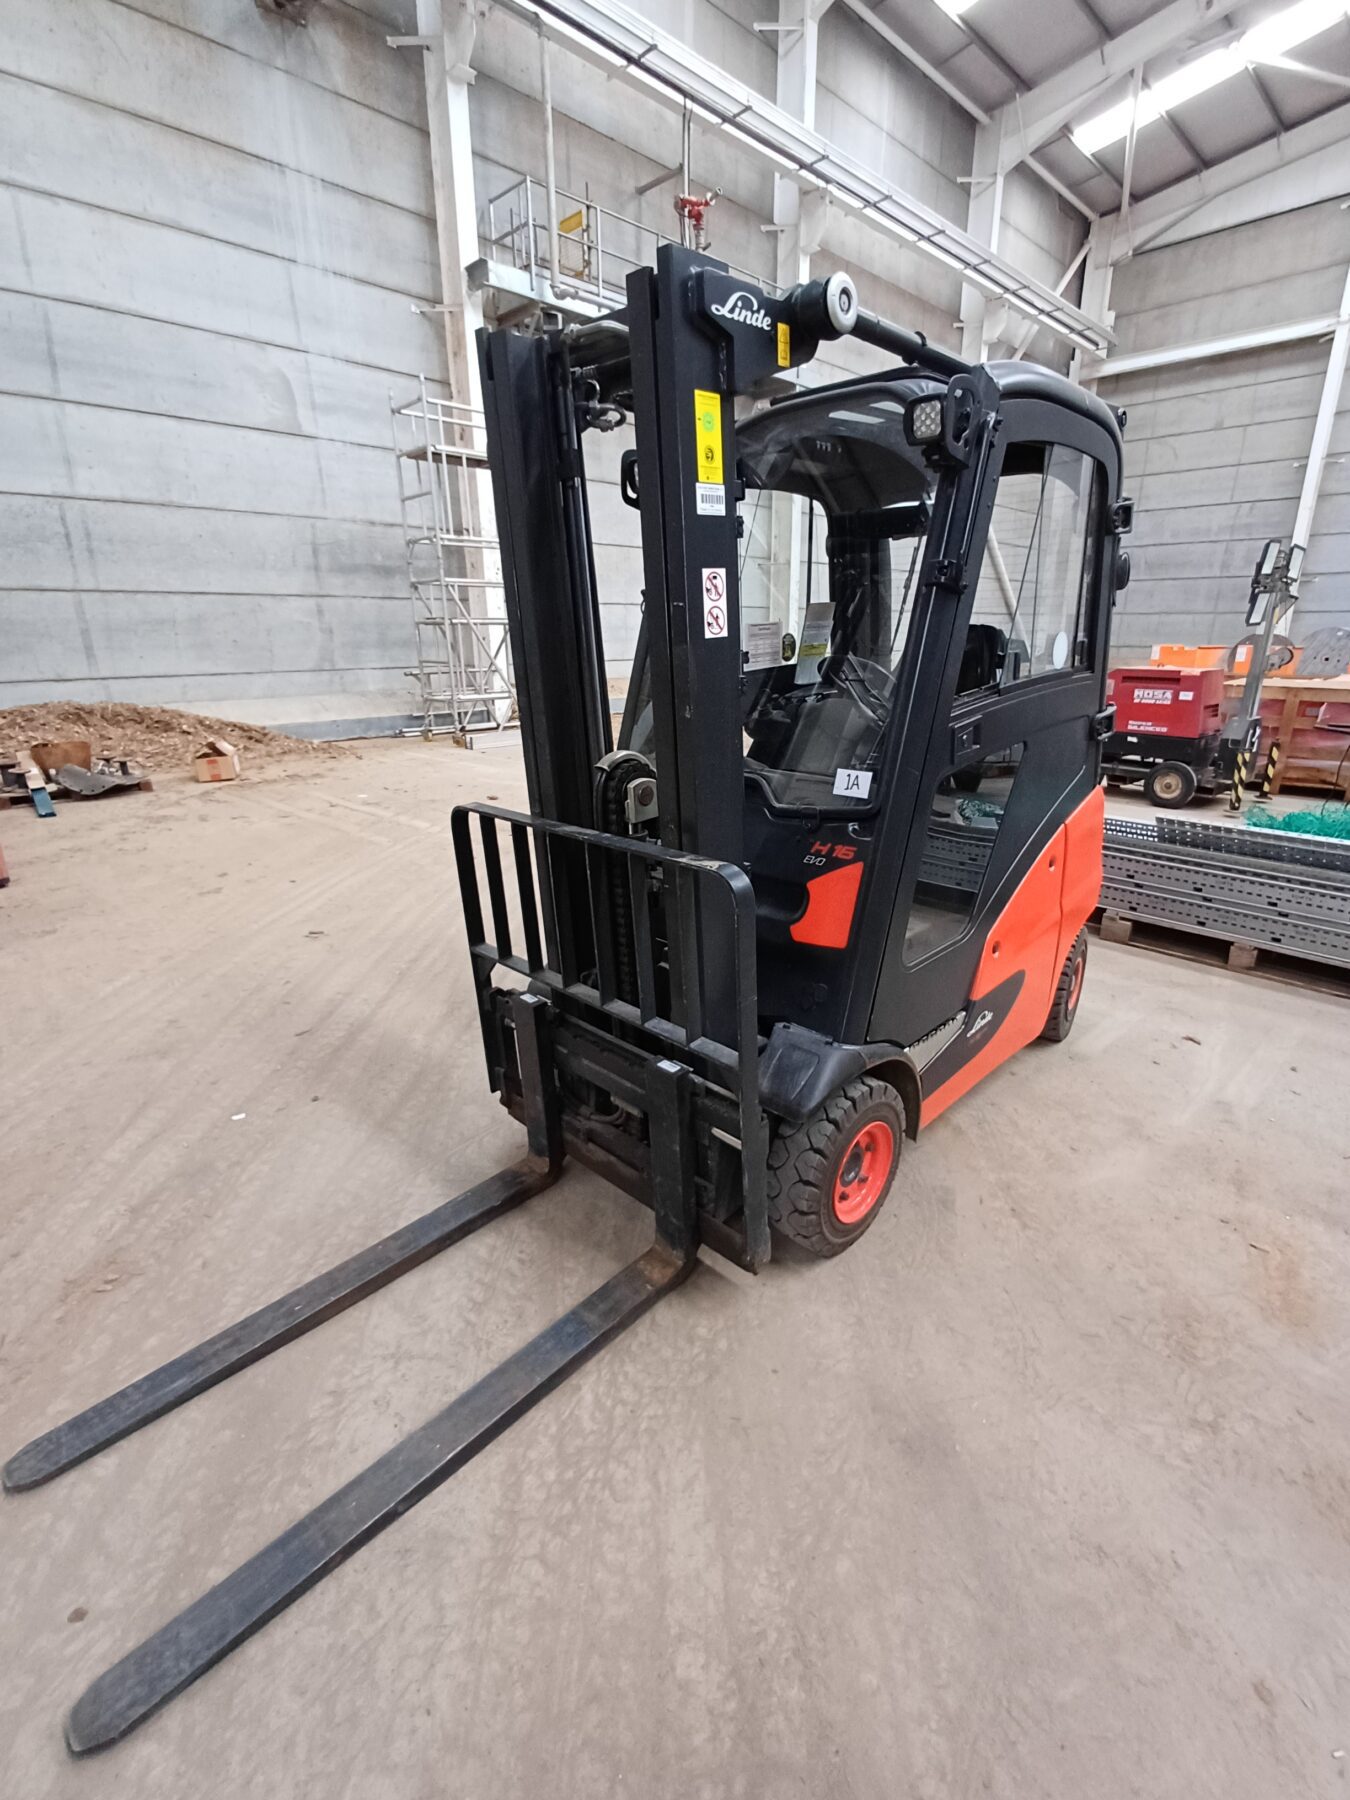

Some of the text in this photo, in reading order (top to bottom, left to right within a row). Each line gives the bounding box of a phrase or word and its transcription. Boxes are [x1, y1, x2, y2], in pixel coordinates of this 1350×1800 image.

[711, 291, 772, 331] Linde
[843, 773, 861, 791] 1A
[803, 855, 826, 866] EVO
